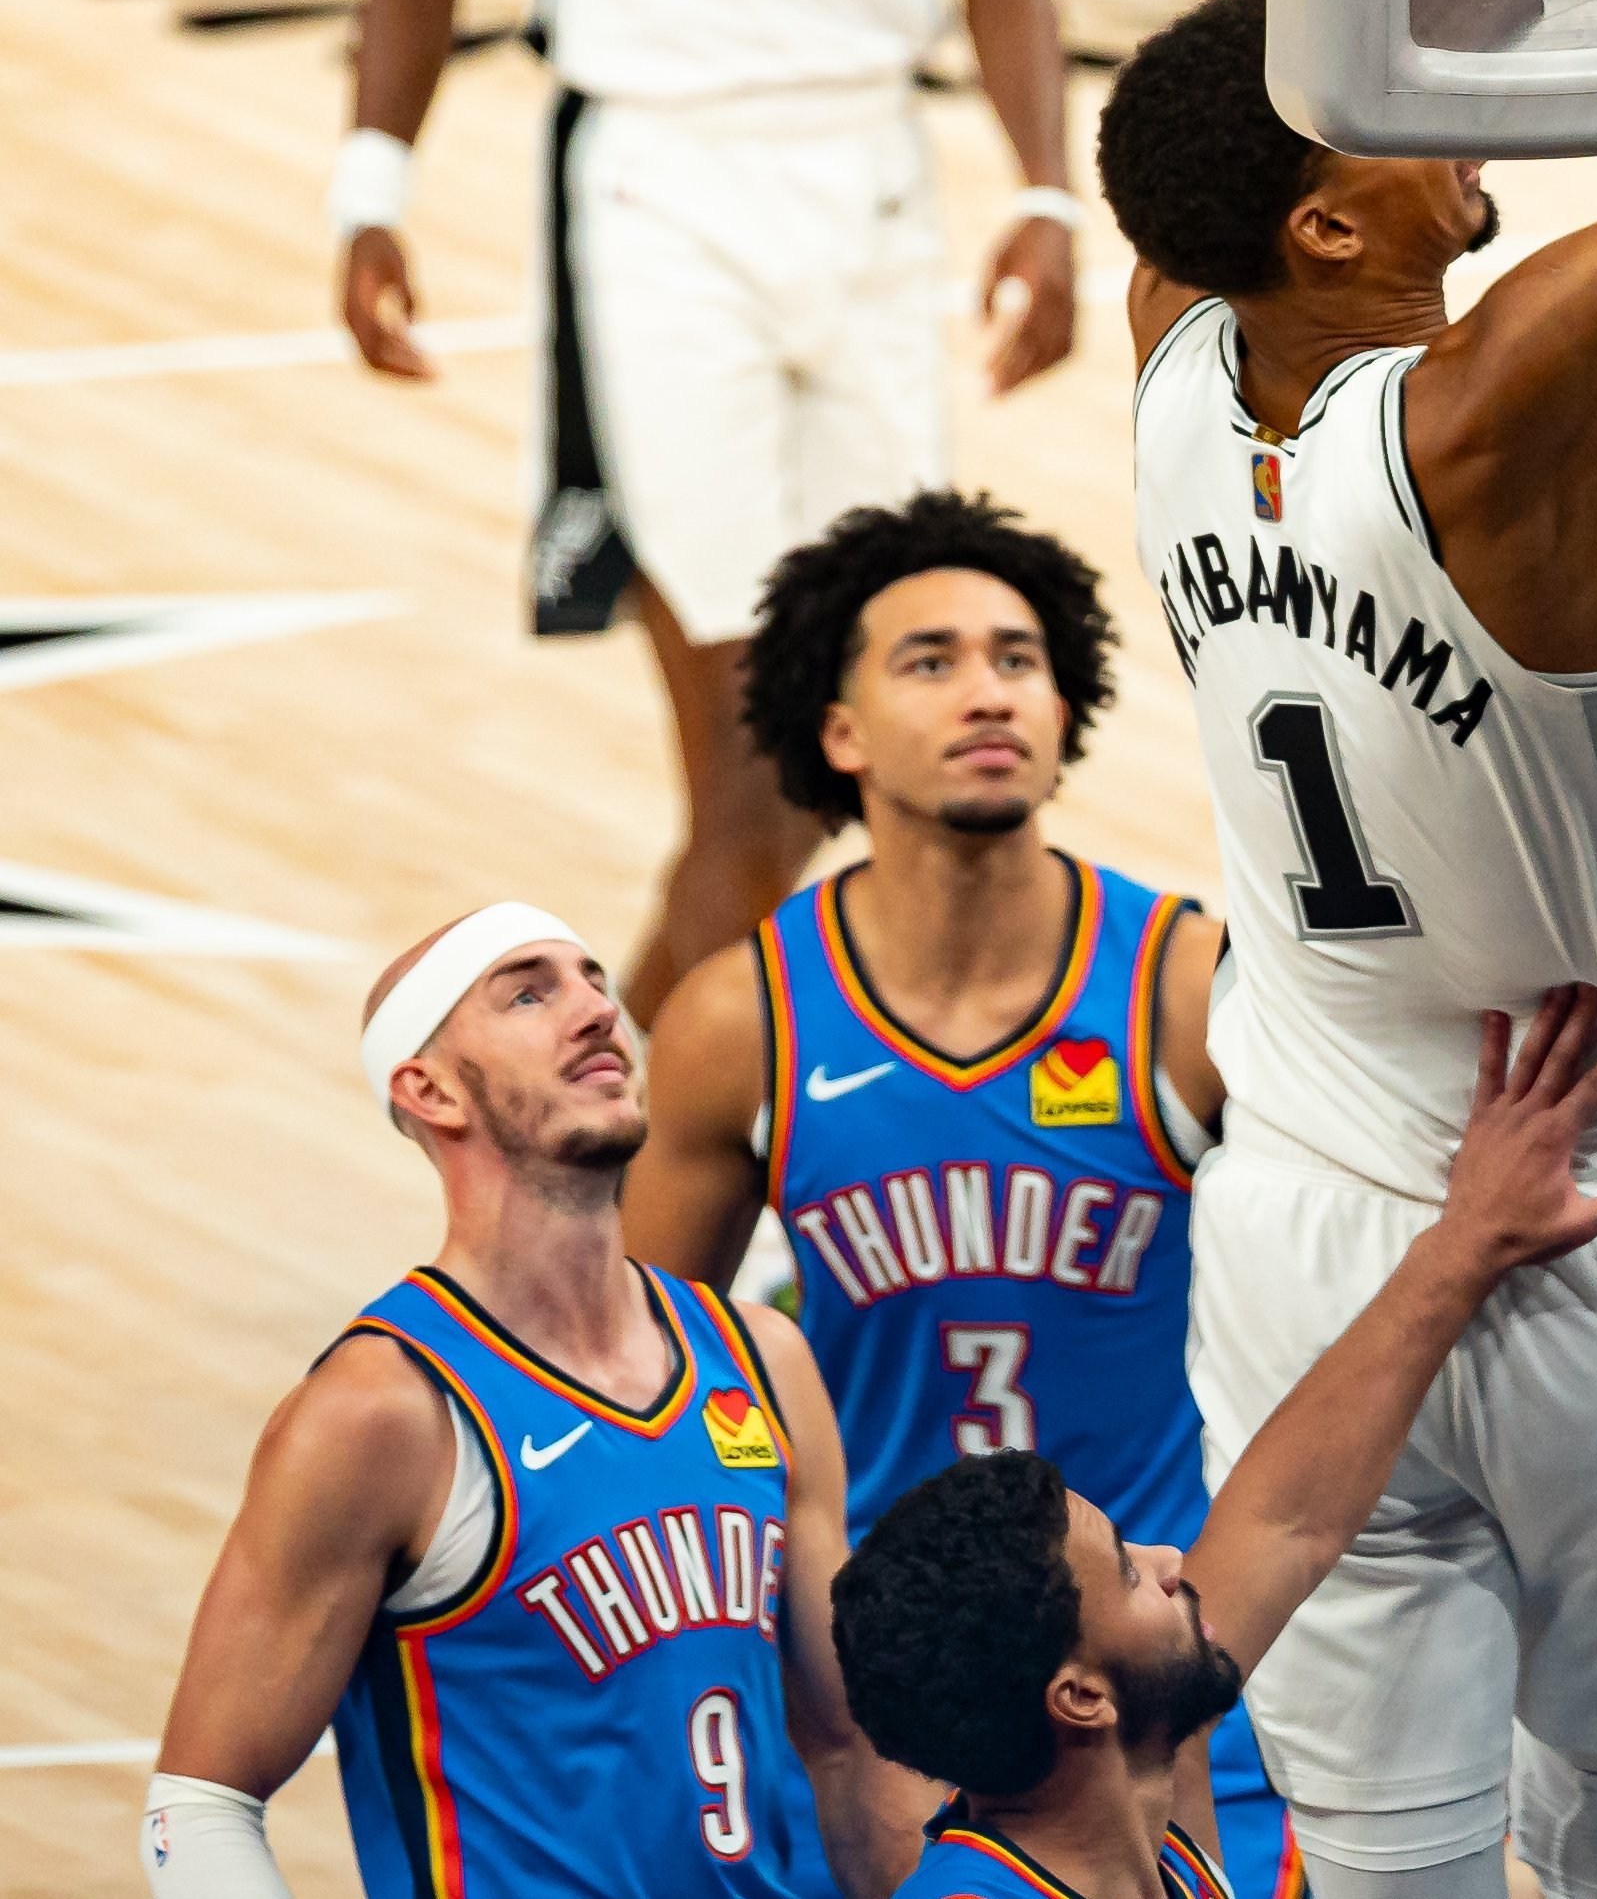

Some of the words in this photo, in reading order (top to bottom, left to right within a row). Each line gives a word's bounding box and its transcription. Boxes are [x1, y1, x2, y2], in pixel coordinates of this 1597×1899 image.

[1246, 689, 1425, 942] 1
[789, 1159, 1166, 1310] THUNDER
[939, 1319, 1036, 1456] 3
[515, 1503, 786, 1684] THUNDE
[687, 1686, 754, 1862] 9
